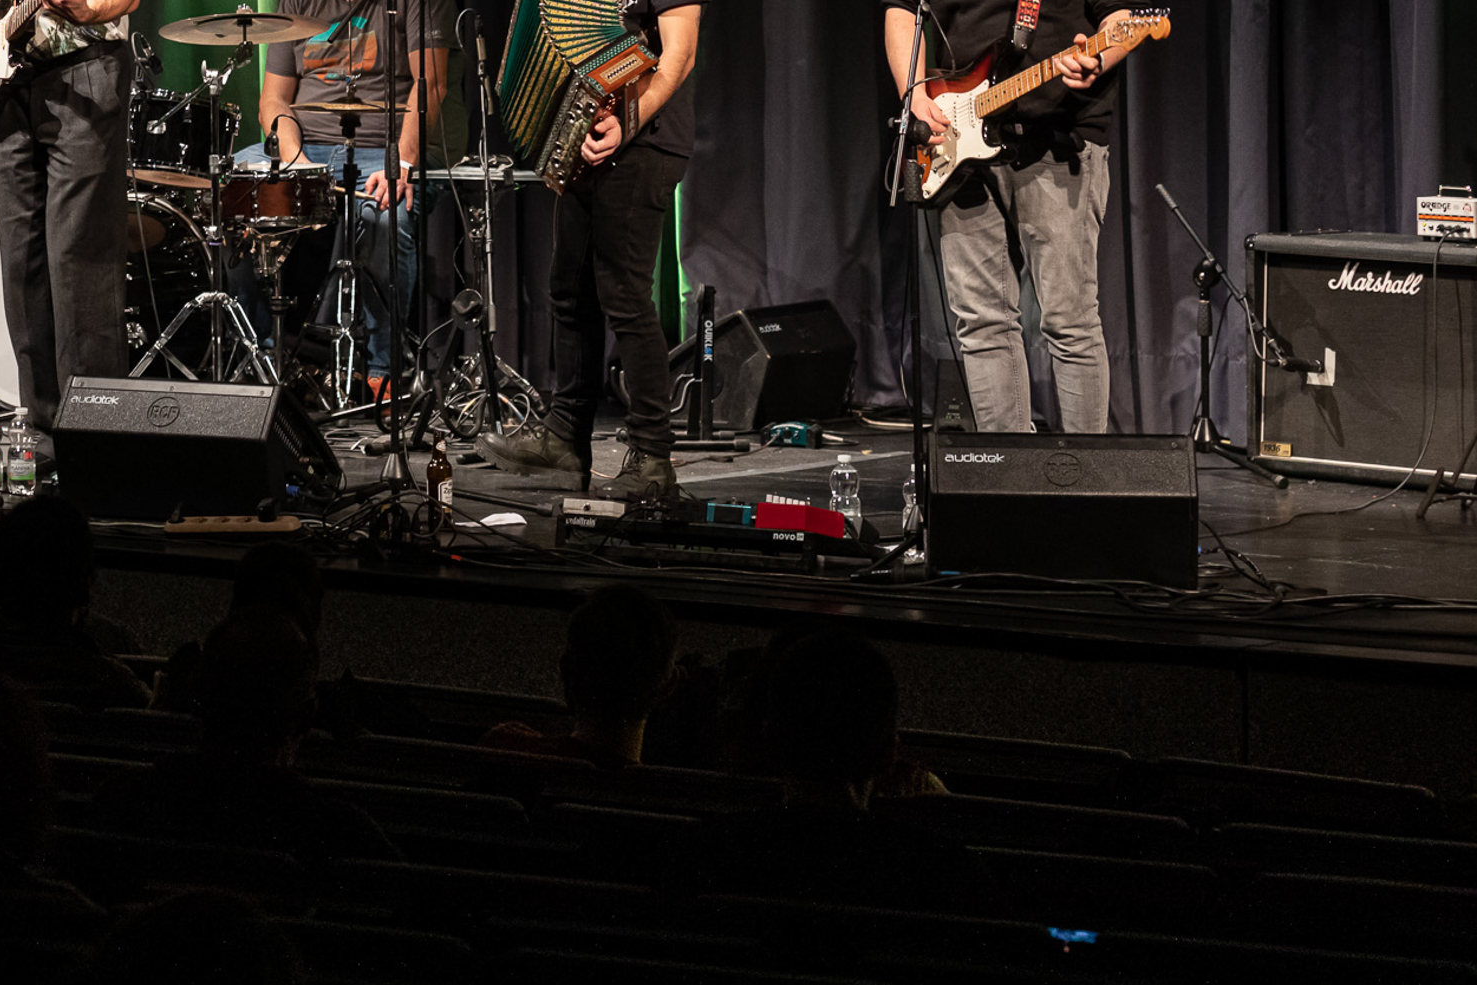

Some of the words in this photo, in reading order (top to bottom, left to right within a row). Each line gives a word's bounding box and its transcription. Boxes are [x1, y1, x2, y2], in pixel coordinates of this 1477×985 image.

[1327, 261, 1424, 295] Marshall
[70, 395, 121, 406] audiotek
[944, 453, 1006, 464] audiotek
[772, 532, 796, 541] novo
